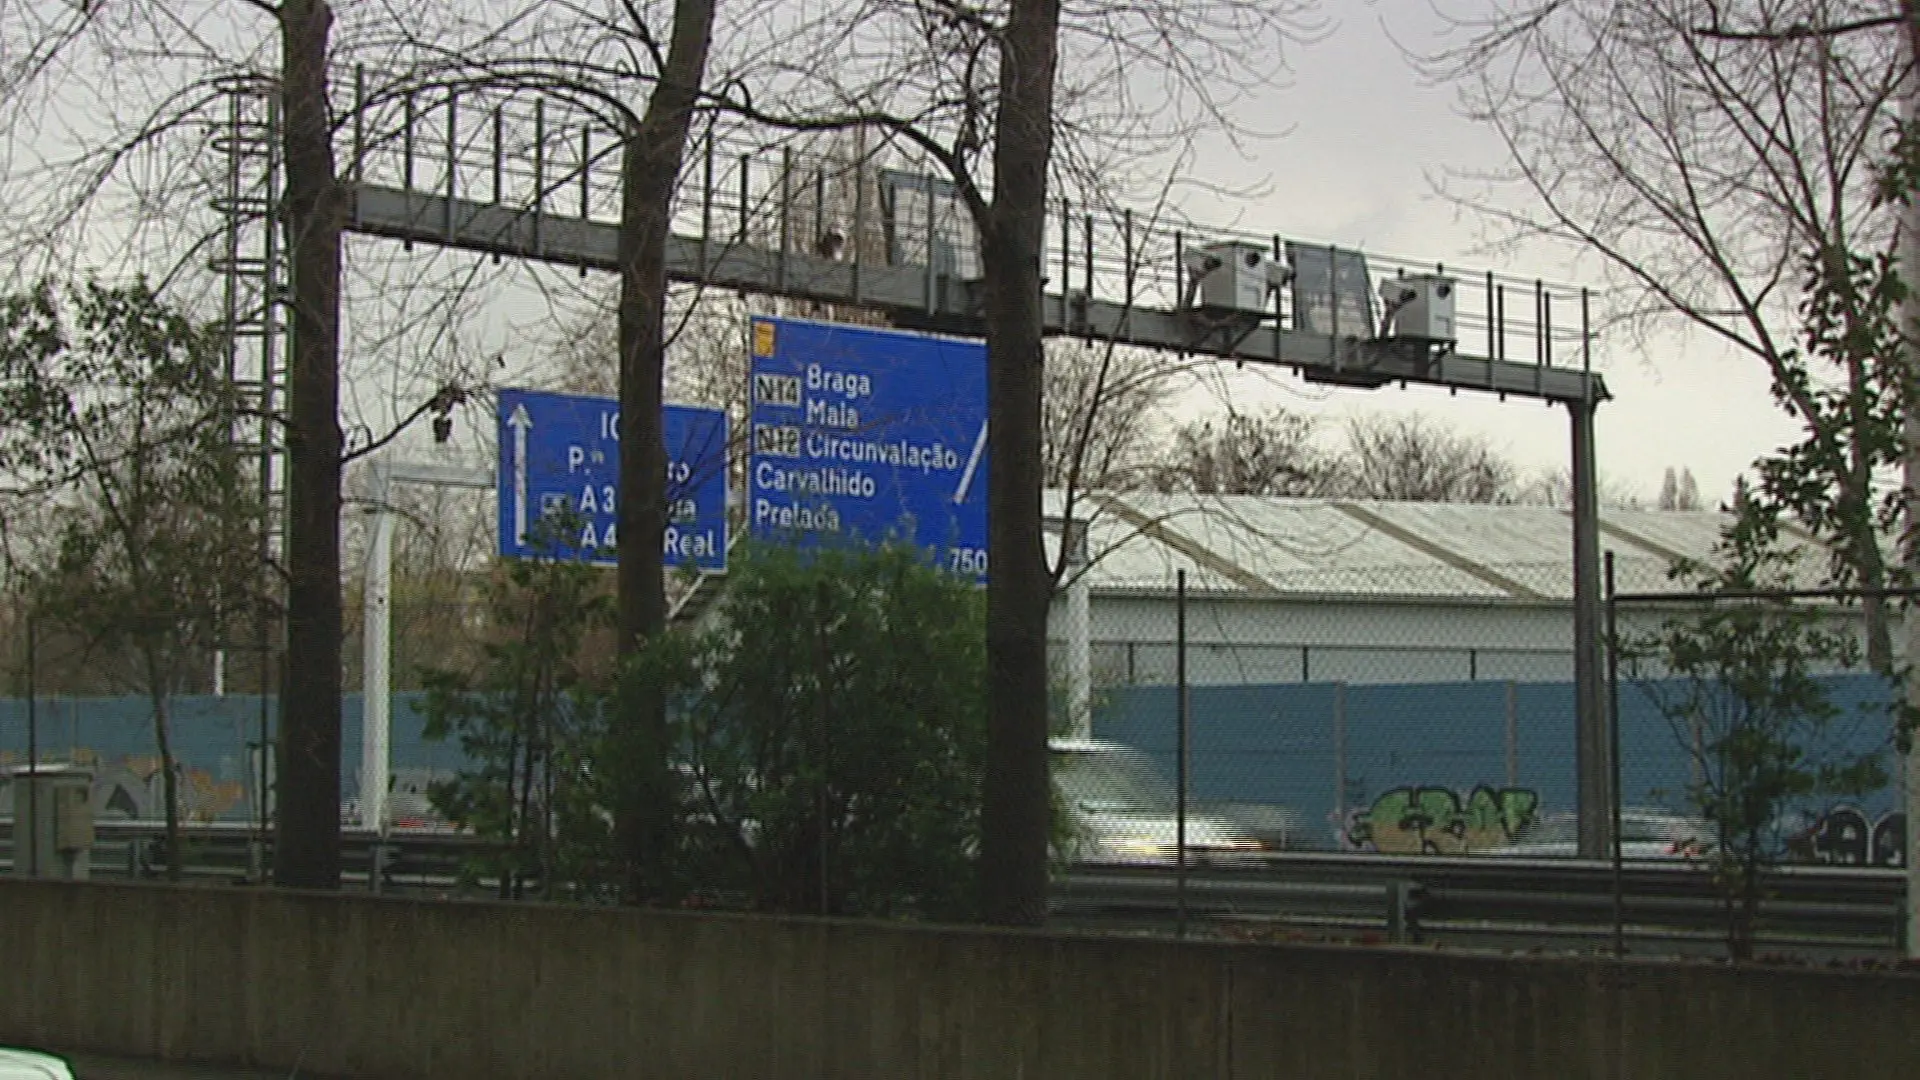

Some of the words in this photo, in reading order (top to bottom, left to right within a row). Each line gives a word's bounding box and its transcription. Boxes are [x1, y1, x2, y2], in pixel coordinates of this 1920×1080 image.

[756, 376, 799, 403] N14
[806, 363, 871, 397] Braga
[806, 398, 859, 428] Maia
[806, 432, 958, 474] Circunvalação
[756, 462, 876, 497] Carvalhido
[756, 500, 840, 531] Prelada
[663, 527, 716, 557] Real
[950, 549, 988, 575] 750
